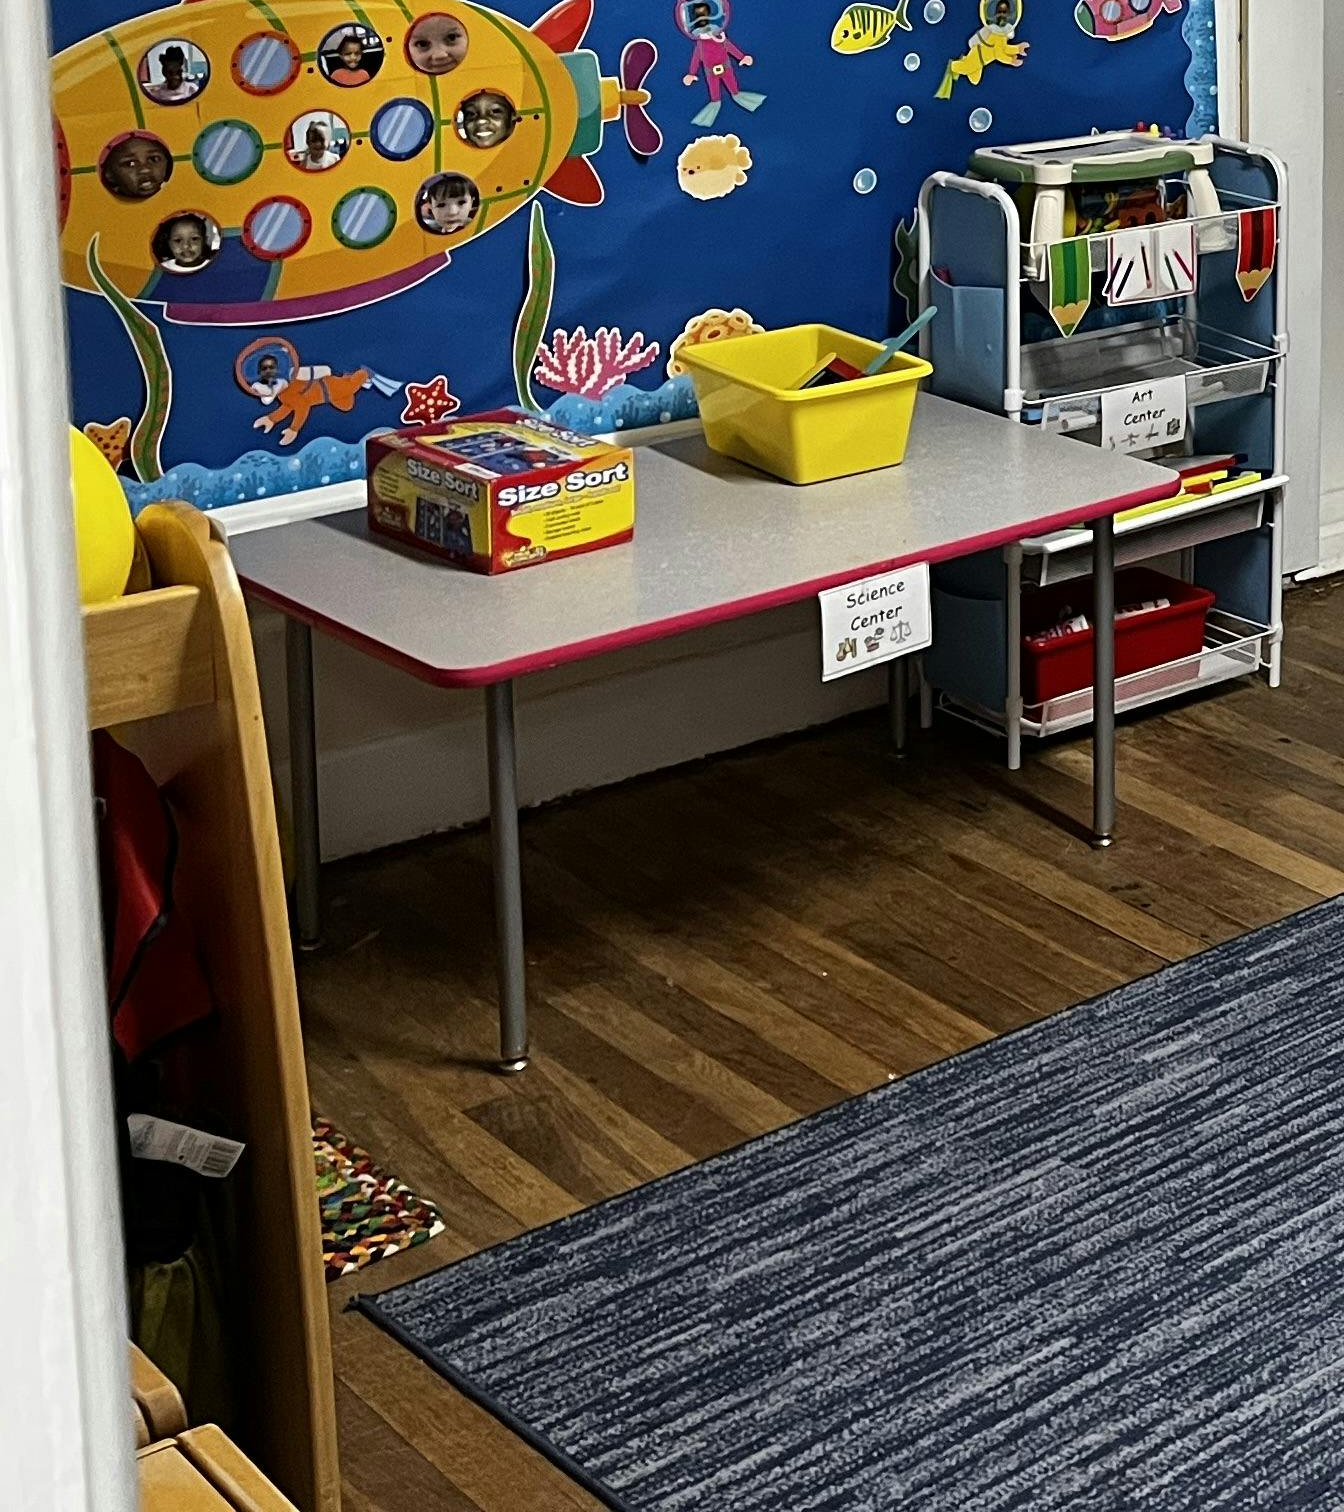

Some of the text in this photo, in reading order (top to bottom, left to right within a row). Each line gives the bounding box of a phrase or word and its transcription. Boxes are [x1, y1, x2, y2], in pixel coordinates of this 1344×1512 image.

[1132, 390, 1153, 403] Art
[1124, 409, 1165, 425] Center
[407, 459, 479, 501] Size Sort
[498, 480, 560, 506] Size
[566, 462, 628, 492] Sort
[847, 581, 905, 608] Science
[851, 606, 902, 631] Center
